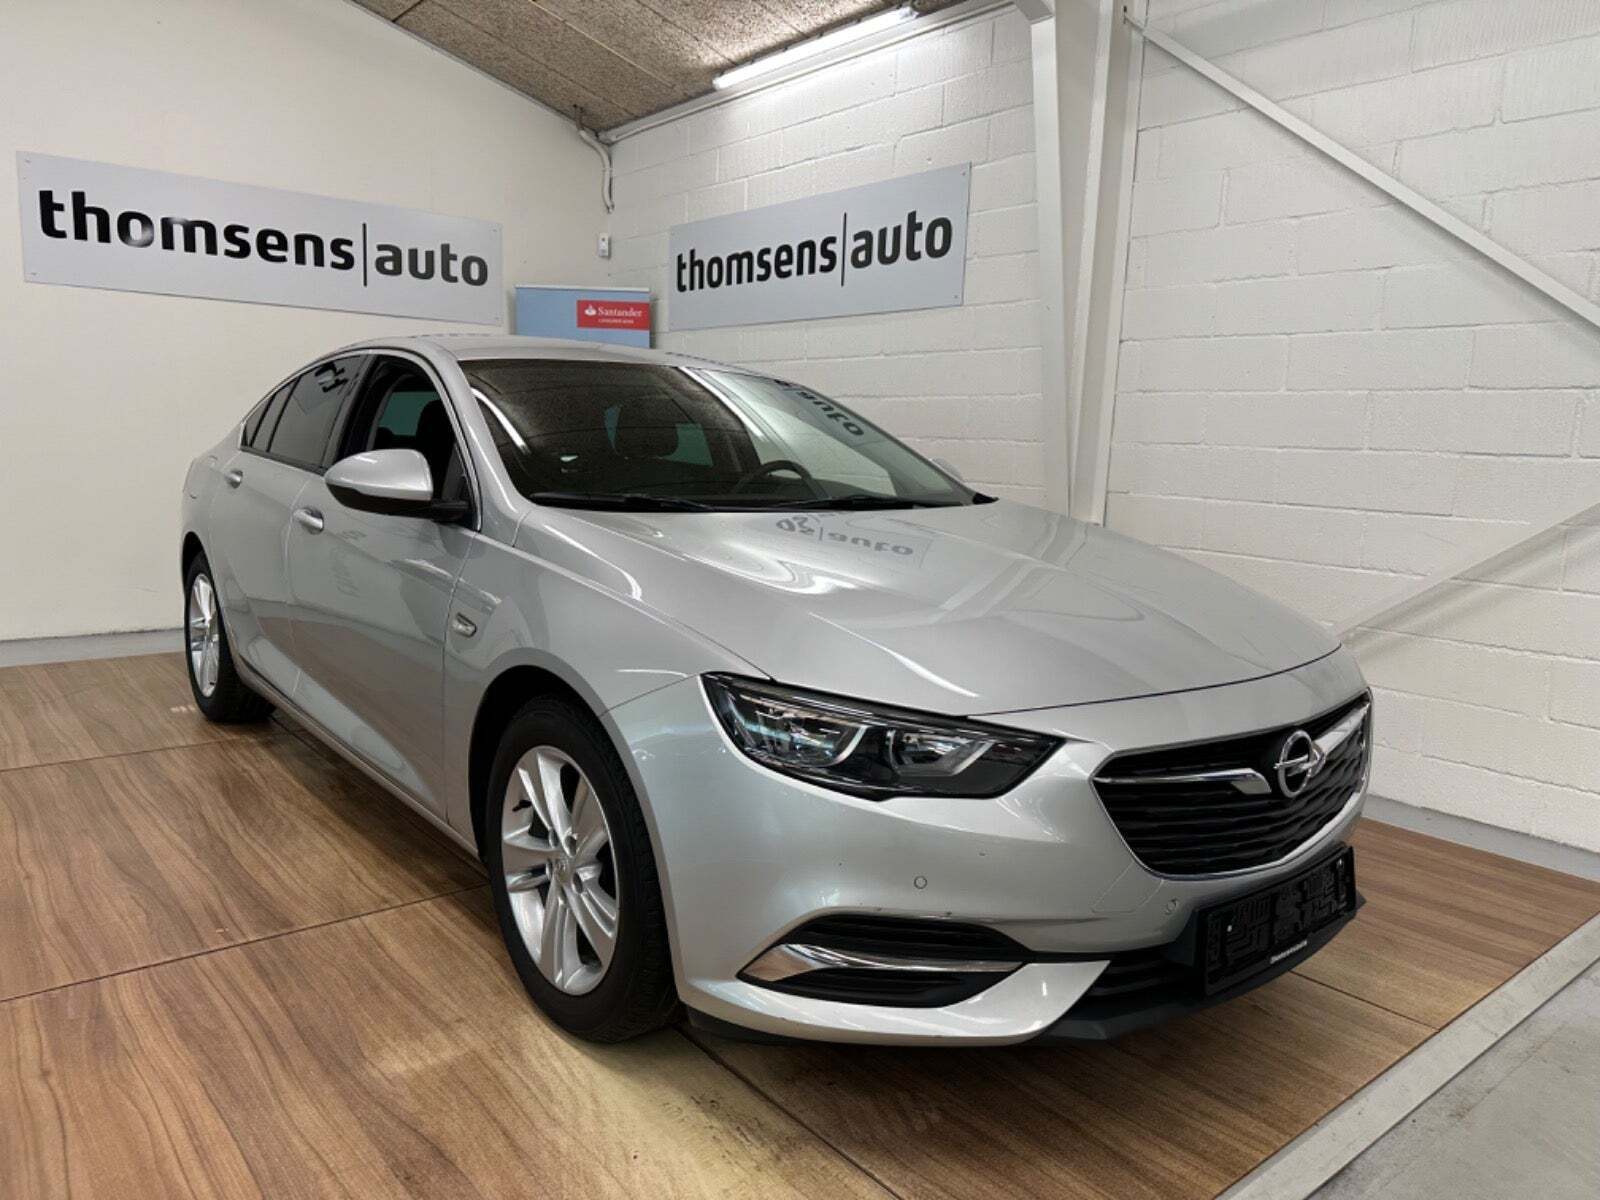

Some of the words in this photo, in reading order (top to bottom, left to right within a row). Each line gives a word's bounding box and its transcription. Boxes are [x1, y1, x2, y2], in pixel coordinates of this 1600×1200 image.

[38, 189, 355, 270] thomsens
[374, 243, 489, 287] auto
[676, 235, 838, 293] thomsens
[849, 210, 954, 270] auto
[597, 306, 643, 317] Santander
